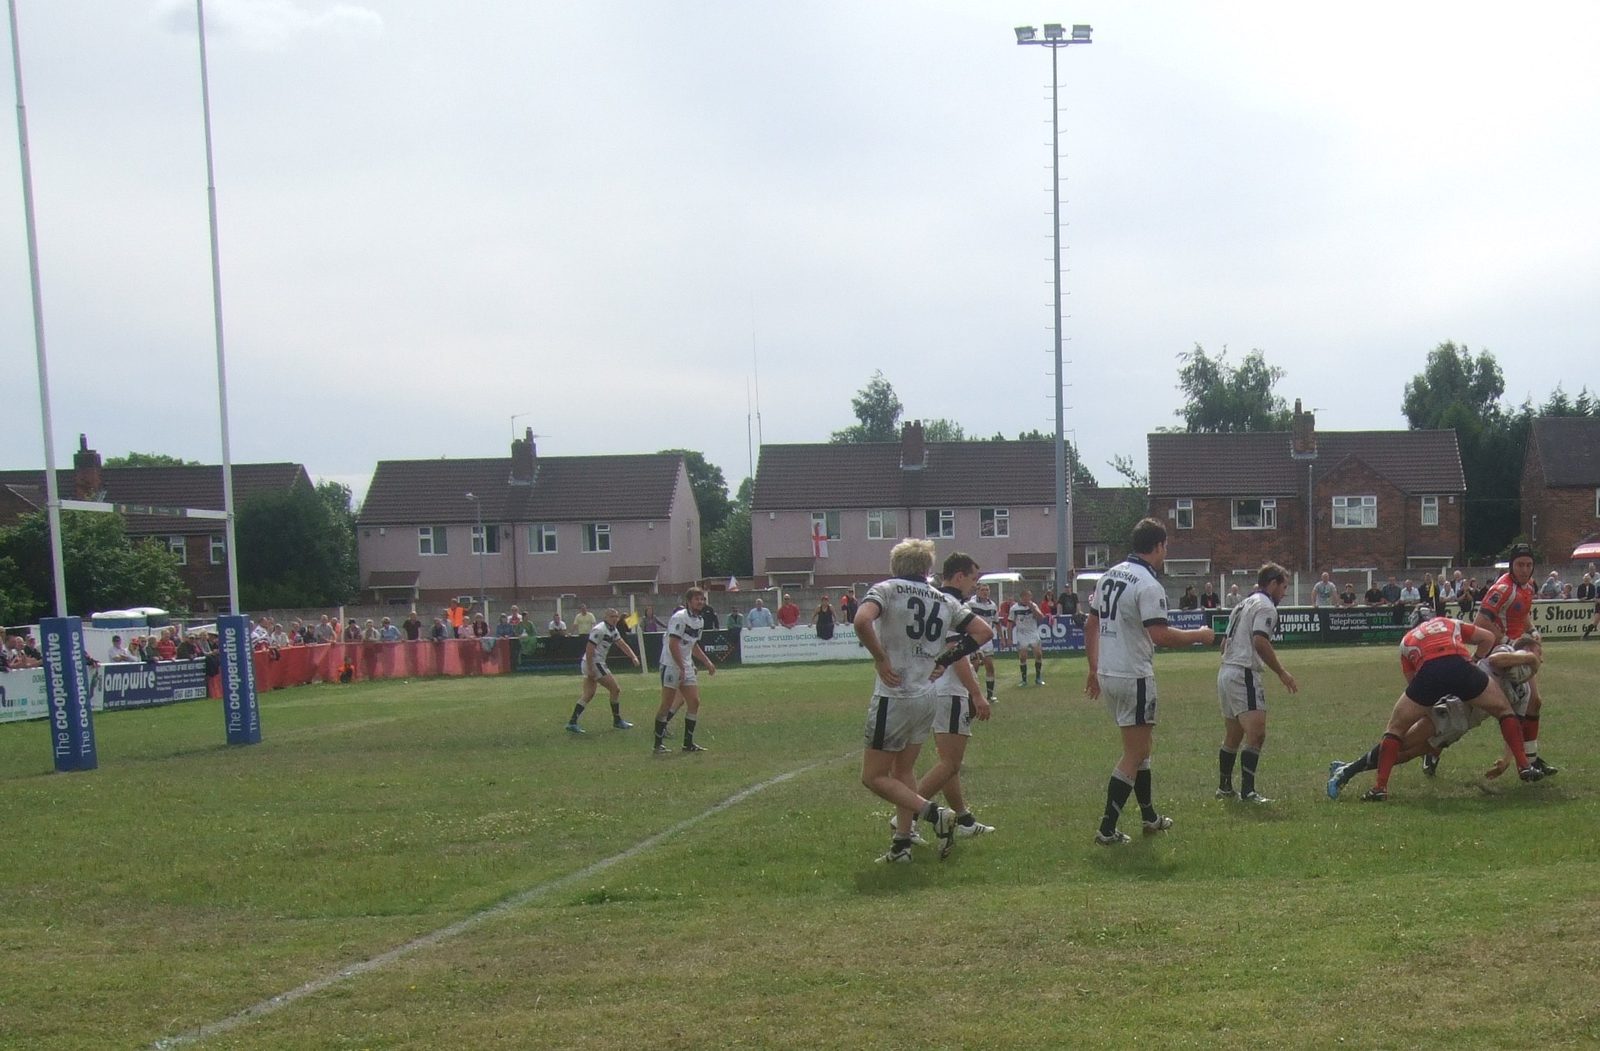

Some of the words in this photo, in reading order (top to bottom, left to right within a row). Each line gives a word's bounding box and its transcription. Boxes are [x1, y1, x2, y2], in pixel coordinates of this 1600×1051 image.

[1100, 578, 1127, 620] 37
[906, 596, 943, 642] 36
[1177, 613, 1204, 622] SUPPORT
[1279, 614, 1312, 623] TIMBER
[1313, 613, 1320, 621] &
[1545, 605, 1594, 621] Showr
[743, 635, 766, 643] Grow
[767, 631, 818, 642] scrum-sciou
[1280, 623, 1321, 632] SUPPLIES
[1557, 624, 1577, 633] 0161
[47, 632, 68, 730] co-operative
[71, 631, 88, 728] co-operative
[104, 664, 156, 698] ampwire
[223, 627, 242, 710] co-operative
[229, 711, 242, 734] The
[57, 732, 71, 758] The
[81, 730, 91, 757] The
